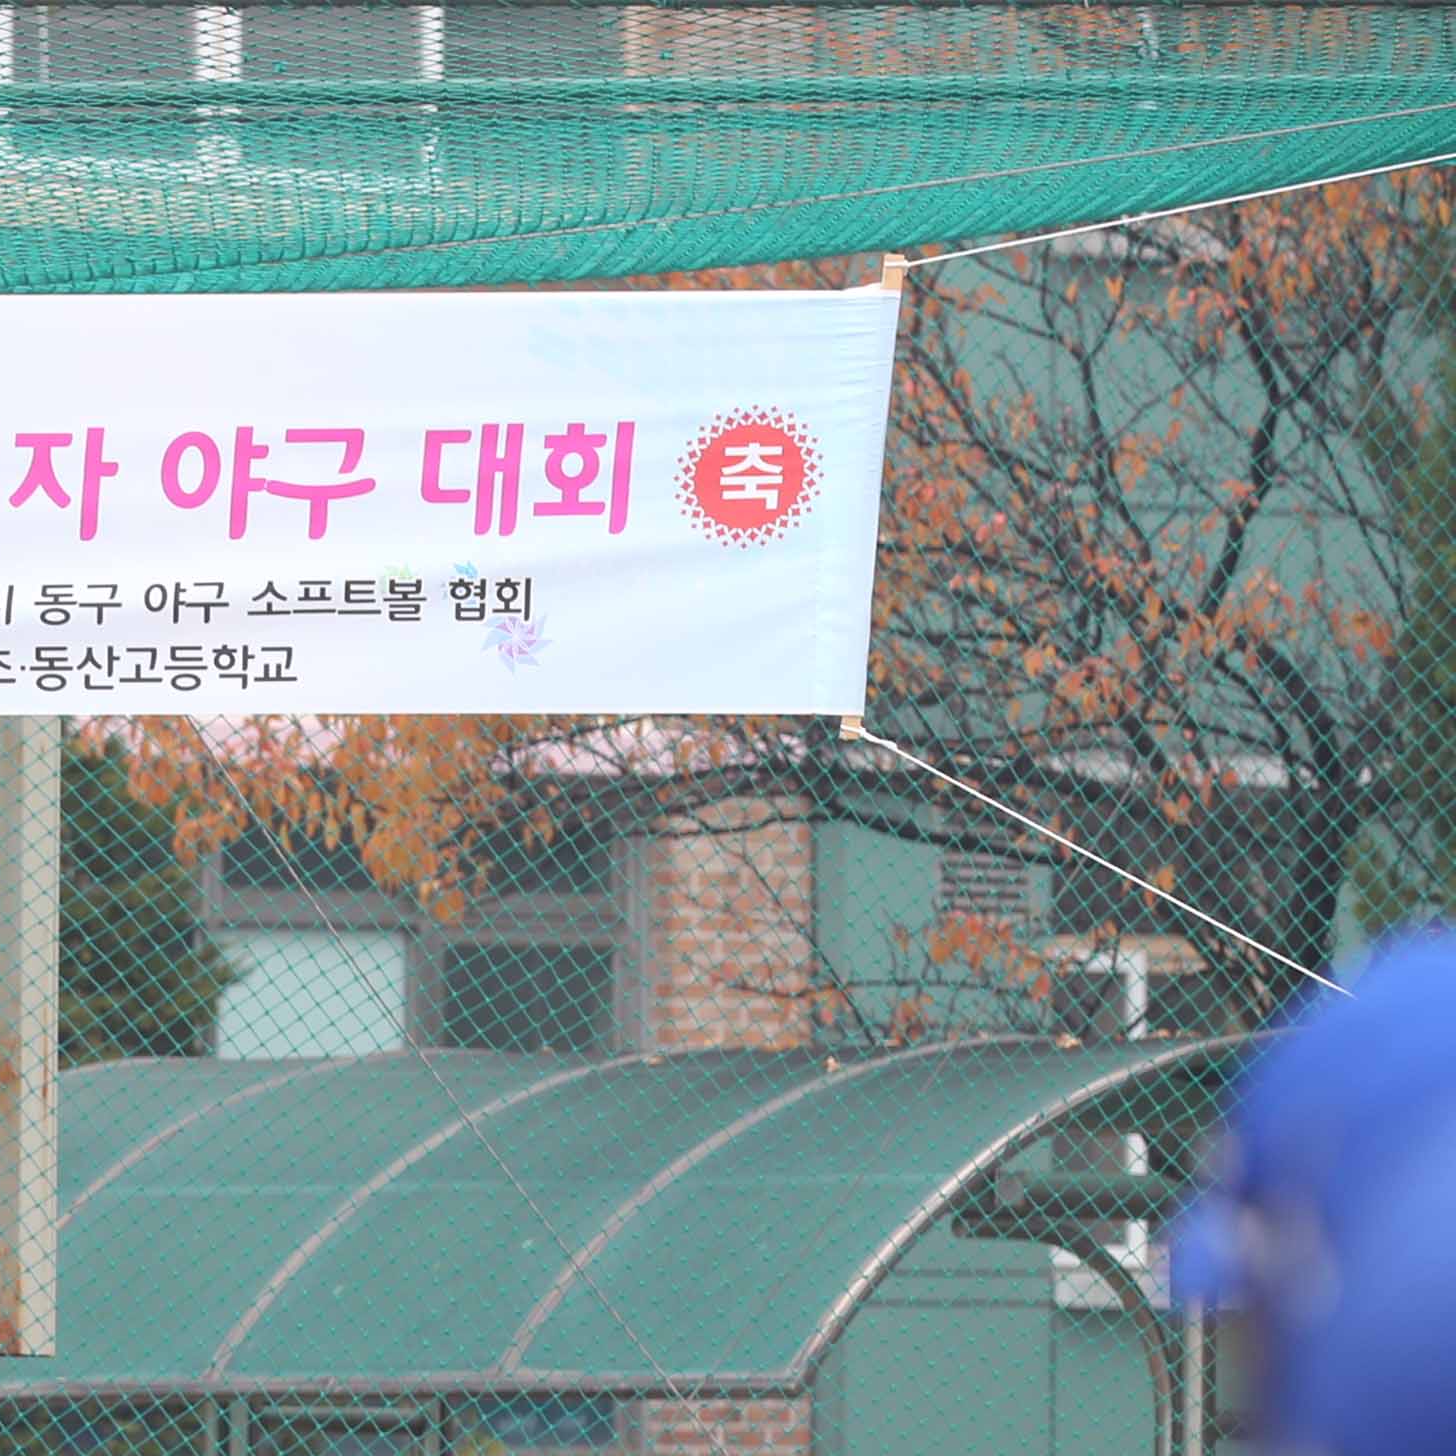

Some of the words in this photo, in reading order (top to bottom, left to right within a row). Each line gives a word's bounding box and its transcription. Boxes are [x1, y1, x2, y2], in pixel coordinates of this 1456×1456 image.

[159, 425, 378, 541] 야구
[419, 420, 637, 538] 대회
[719, 442, 784, 511] 축
[34, 584, 122, 626] 동구
[144, 582, 230, 624] 야구
[247, 579, 427, 621] 소프트볼
[449, 577, 532, 621] 협회
